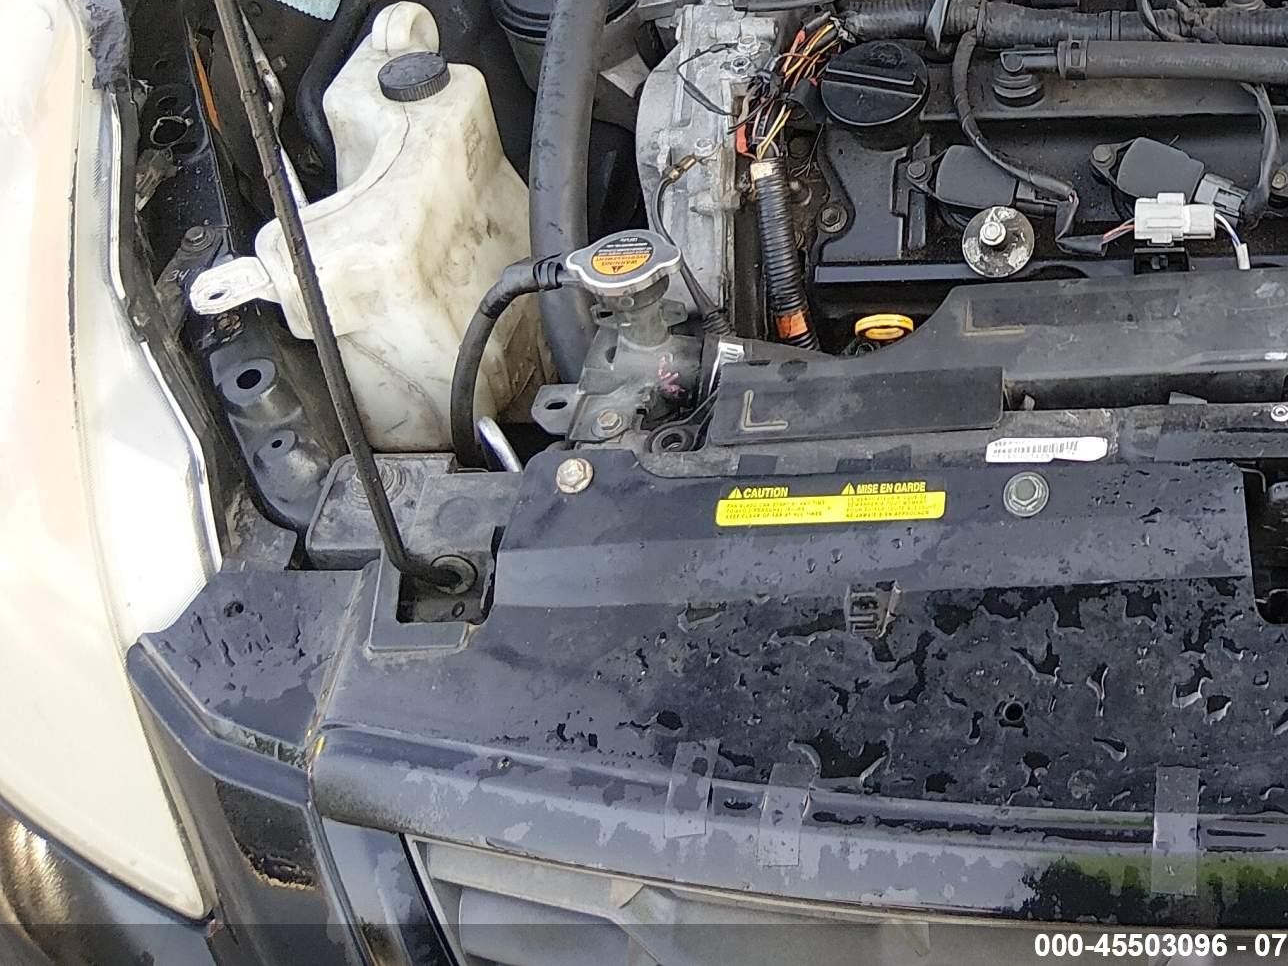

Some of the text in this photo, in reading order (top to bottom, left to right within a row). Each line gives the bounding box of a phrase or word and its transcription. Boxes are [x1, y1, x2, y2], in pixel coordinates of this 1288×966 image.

[743, 486, 789, 499] CAUTION
[856, 481, 926, 494] MISE EN GARDE
